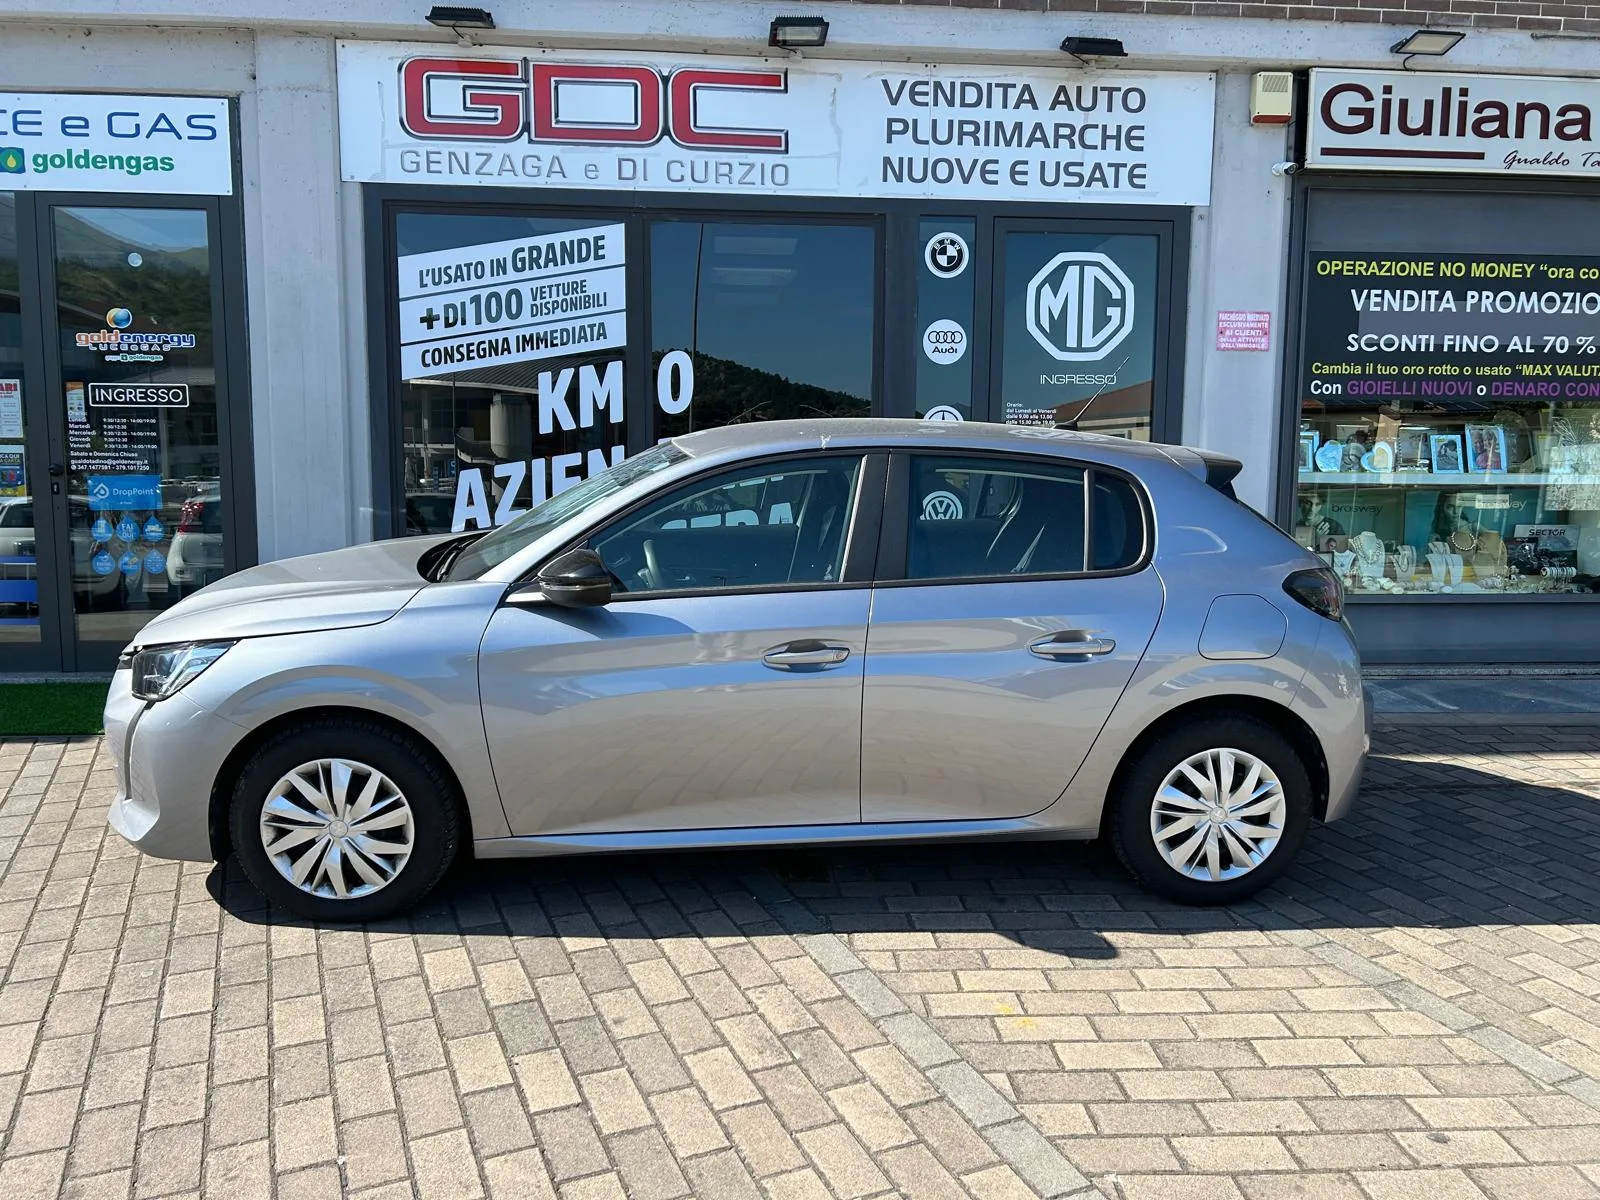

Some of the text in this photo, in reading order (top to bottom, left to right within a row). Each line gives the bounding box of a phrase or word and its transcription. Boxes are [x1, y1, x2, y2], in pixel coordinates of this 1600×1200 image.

[398, 56, 788, 154] GDC
[881, 79, 1146, 113] VENDITA AUTO
[0, 109, 217, 140] E e GAS
[1320, 83, 1592, 141] Giuliana
[886, 117, 1145, 152] PLURIMARCHE
[32, 148, 175, 175] goldengas
[400, 150, 789, 187] GENZAGA e DI CURZIO
[1503, 150, 1570, 169] Gualdo
[881, 156, 1147, 189] NUOVE E USATE
[933, 238, 961, 250] BMW
[419, 234, 606, 288] L'USATO IN GRANDE
[1316, 260, 1434, 277] OPERAZIONE
[1439, 262, 1466, 277] NO
[1470, 263, 1535, 278] MONEY
[530, 279, 587, 302] VETTURE
[1350, 288, 1600, 315] VENDITA PROMOZIO
[469, 287, 523, 325] 100
[530, 291, 607, 318] DISPONIBILI
[1039, 264, 1122, 348] MG
[75, 329, 195, 348] goldenergy
[420, 321, 607, 368] CONSEGNA IMMEDIATA
[932, 345, 958, 354] Audi
[1347, 333, 1596, 355] SCONTI FINO AL 70 %
[129, 353, 163, 362] goldengas
[1312, 362, 1362, 375] Cambia
[1365, 362, 1373, 375] il
[1376, 363, 1398, 375] tuo
[1402, 365, 1424, 375] oro
[1428, 363, 1460, 376] rotto
[1463, 366, 1471, 376] o
[1475, 364, 1511, 376] usato
[1556, 364, 1600, 377] VALUT
[1040, 374, 1117, 385] INGRESSO
[1310, 380, 1600, 397] Con GIOIELLI NUOVI o DENARO CON
[95, 388, 183, 402] INGRESSO
[537, 351, 694, 435] KM 0
[112, 488, 154, 496] DropPoint
[1331, 502, 1383, 516] brosway
[1528, 528, 1566, 537] SECTOR
